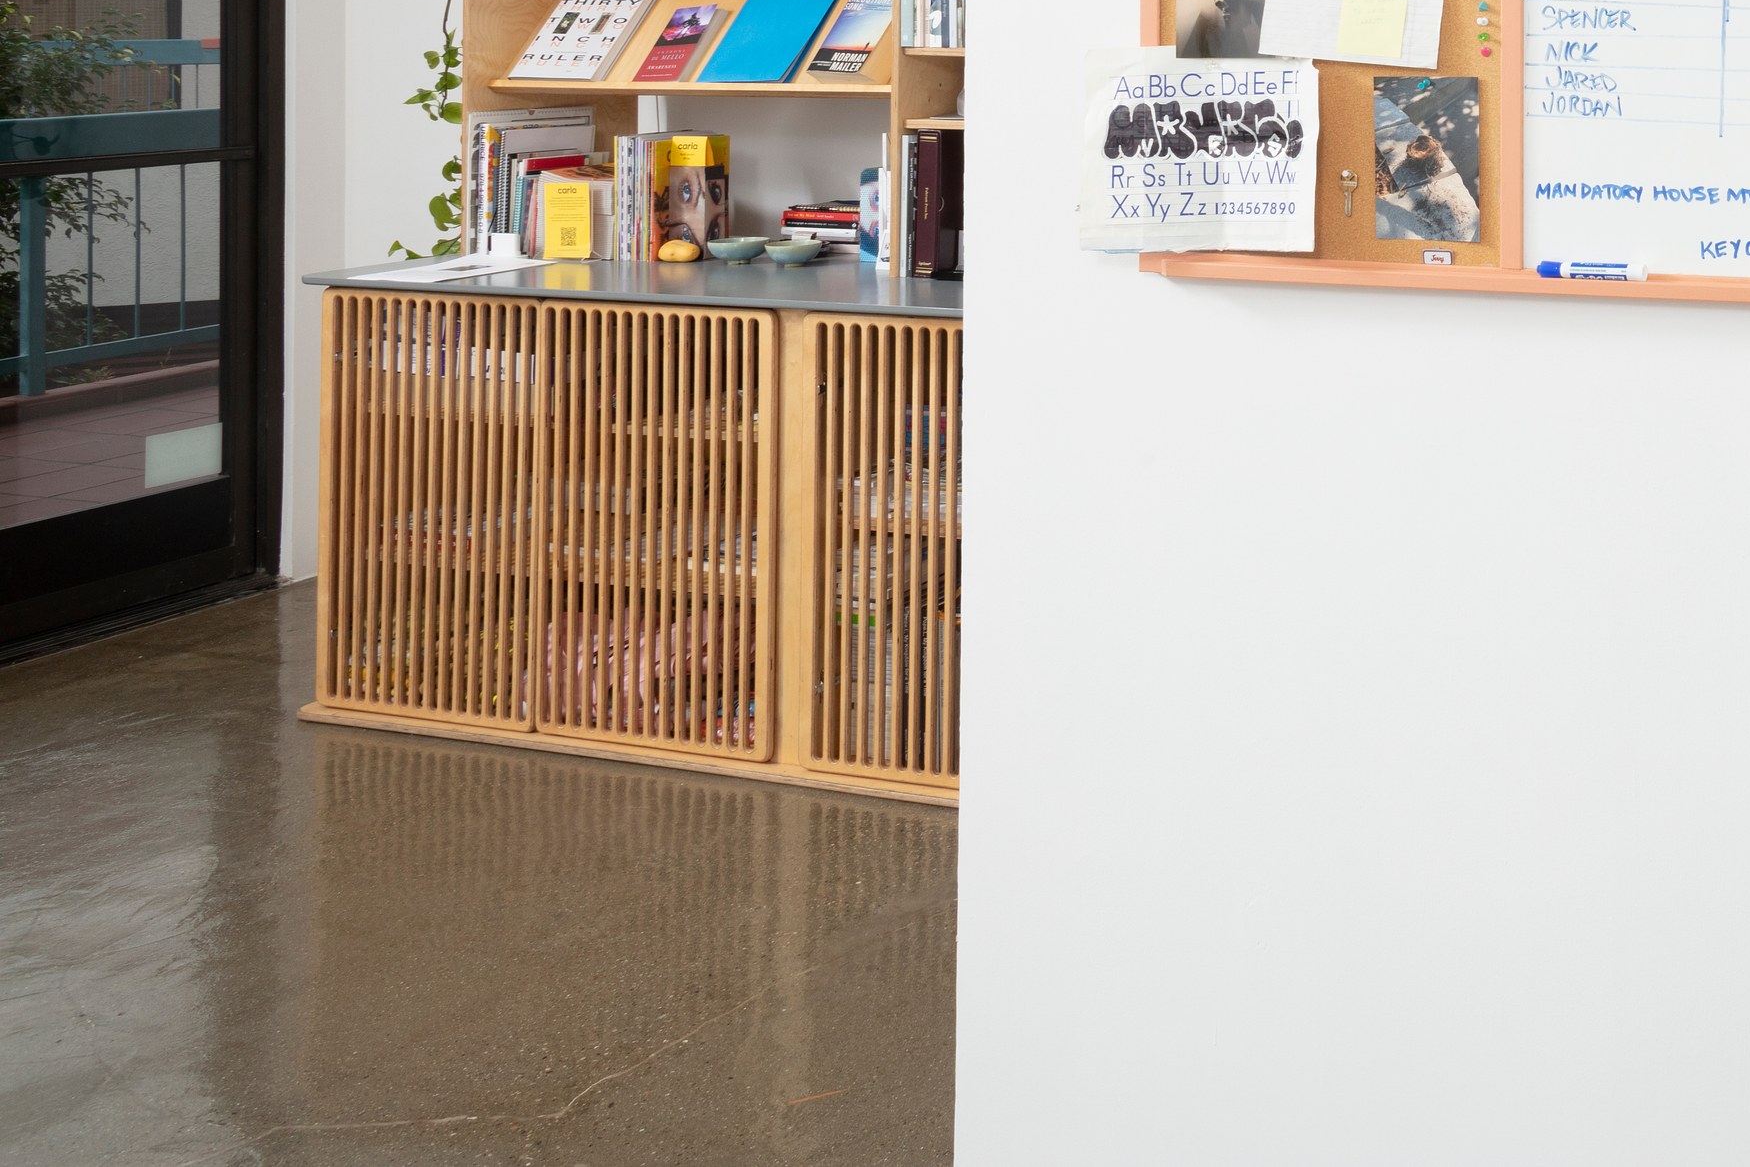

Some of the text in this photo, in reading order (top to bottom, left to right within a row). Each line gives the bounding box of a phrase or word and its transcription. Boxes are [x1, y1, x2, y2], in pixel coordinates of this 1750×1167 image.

[844, 3, 864, 11] SONG
[1541, 5, 1637, 31] SPENCER
[522, 53, 603, 61] RULER
[830, 52, 869, 62] NORMAN
[1545, 39, 1600, 62] NICK
[828, 61, 862, 72] MAILER
[1113, 76, 1144, 100] Aa
[1149, 74, 1177, 99] Bb
[1179, 72, 1216, 98] Cc
[1220, 72, 1249, 96] Dd
[1253, 71, 1278, 95] Ee
[1545, 65, 1618, 92] JARED
[1542, 91, 1623, 117] JORDAN
[677, 141, 698, 150] carla
[1111, 160, 1297, 189] Rr Ss Tt Uu Vv Ww
[557, 185, 577, 194] carla
[1535, 183, 1644, 204] MANDATORY
[1652, 185, 1720, 205] HOUSE
[1111, 192, 1296, 223] Xx Yy Zz 1234567890
